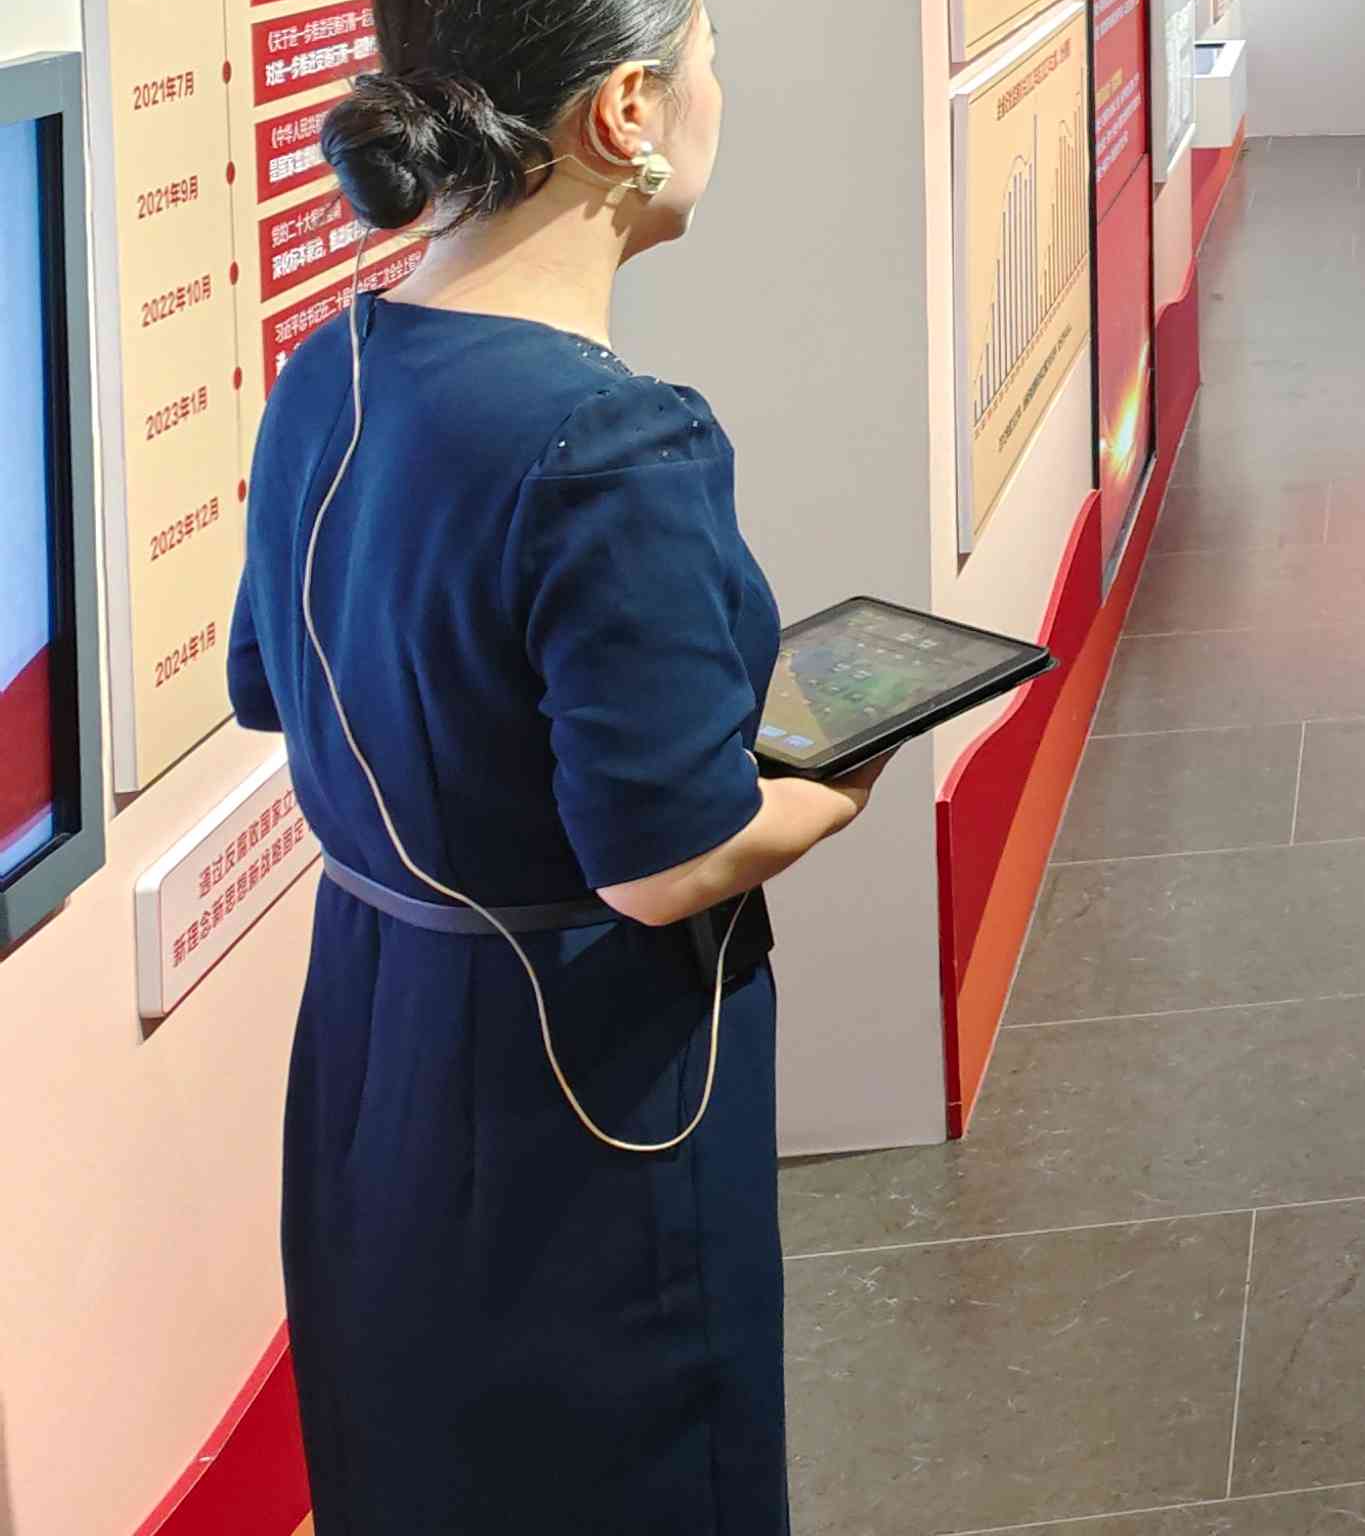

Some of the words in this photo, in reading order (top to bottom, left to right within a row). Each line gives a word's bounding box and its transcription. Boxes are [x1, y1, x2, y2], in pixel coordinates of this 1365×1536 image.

[134, 71, 195, 110] 2021年7月
[137, 175, 199, 219] 2021年9月
[141, 274, 212, 328] 2022年10月
[146, 385, 207, 441] 2023年1月
[150, 496, 219, 562] 2023年12月
[155, 621, 216, 688] 2024年1月
[199, 789, 298, 898] 通过反腐败国家立
[171, 816, 308, 968] 新理念新思想新战略固定
